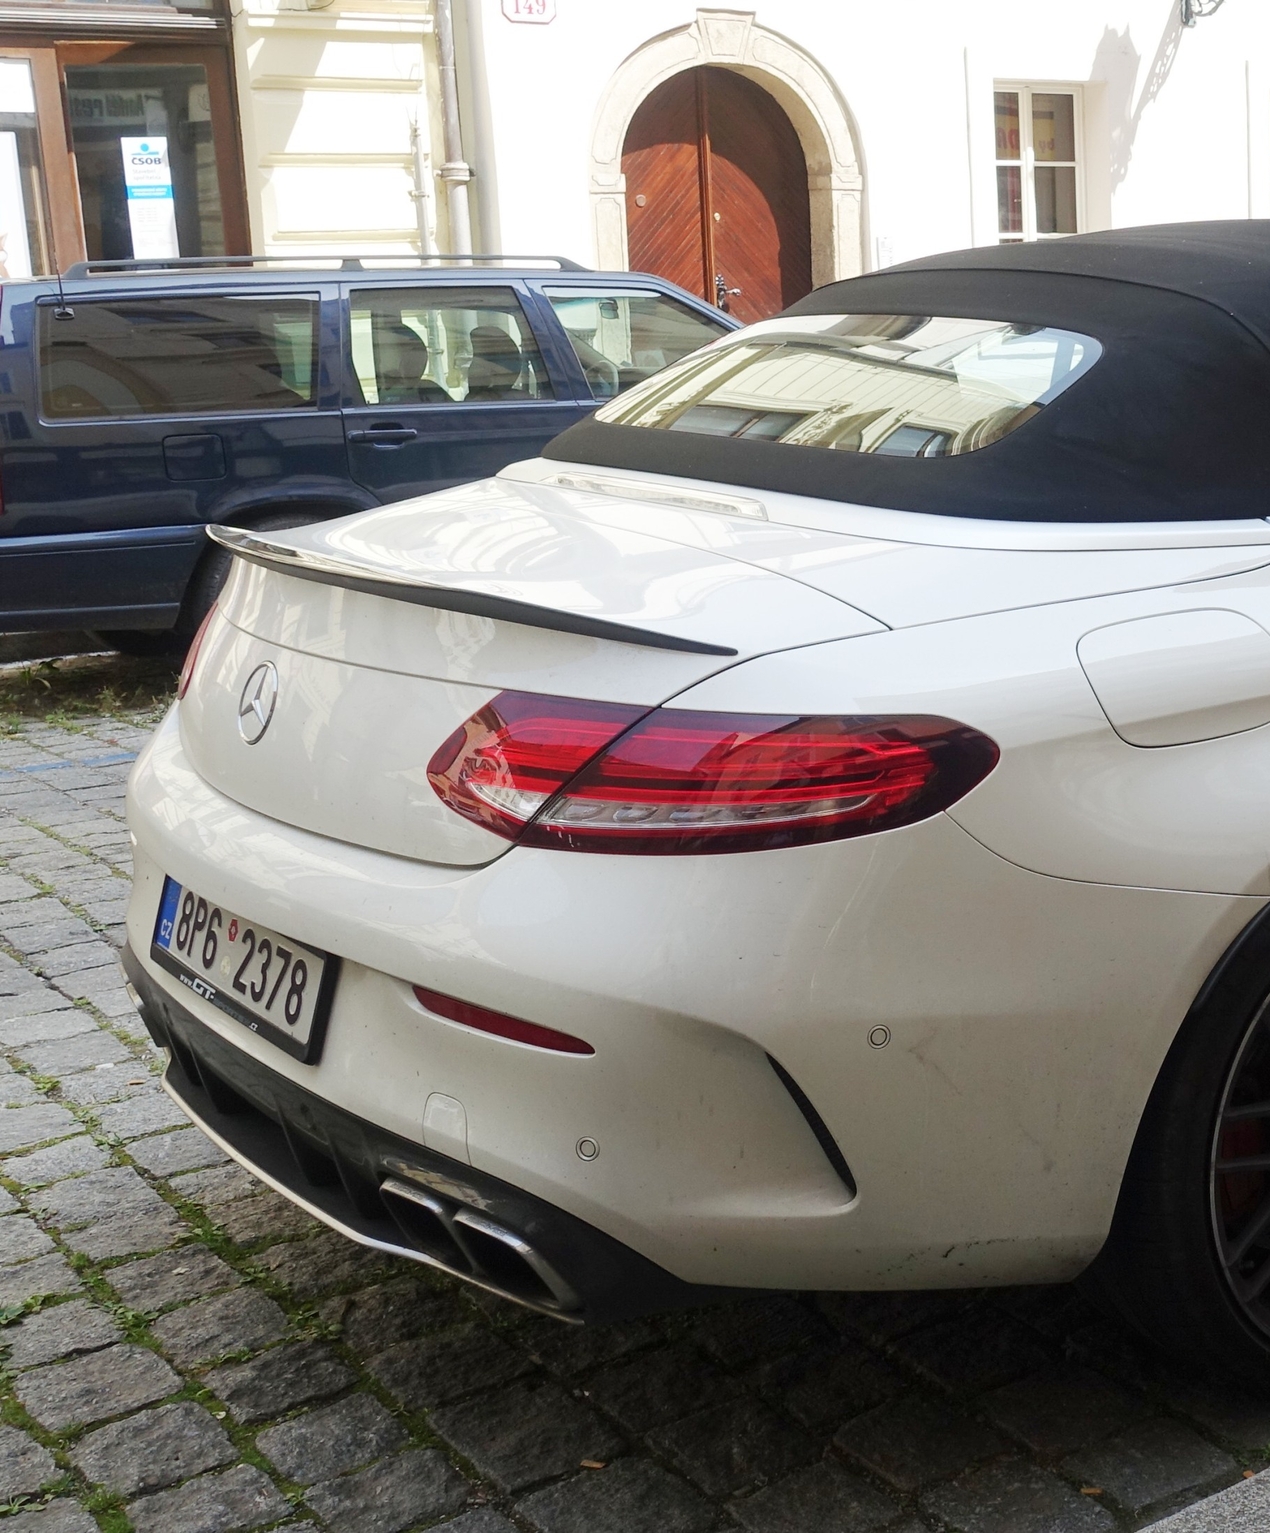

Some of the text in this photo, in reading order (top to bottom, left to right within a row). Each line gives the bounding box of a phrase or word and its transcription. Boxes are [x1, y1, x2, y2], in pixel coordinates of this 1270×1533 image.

[514, 0, 546, 15] 149
[160, 890, 308, 1026] CZ 8P6 2378
